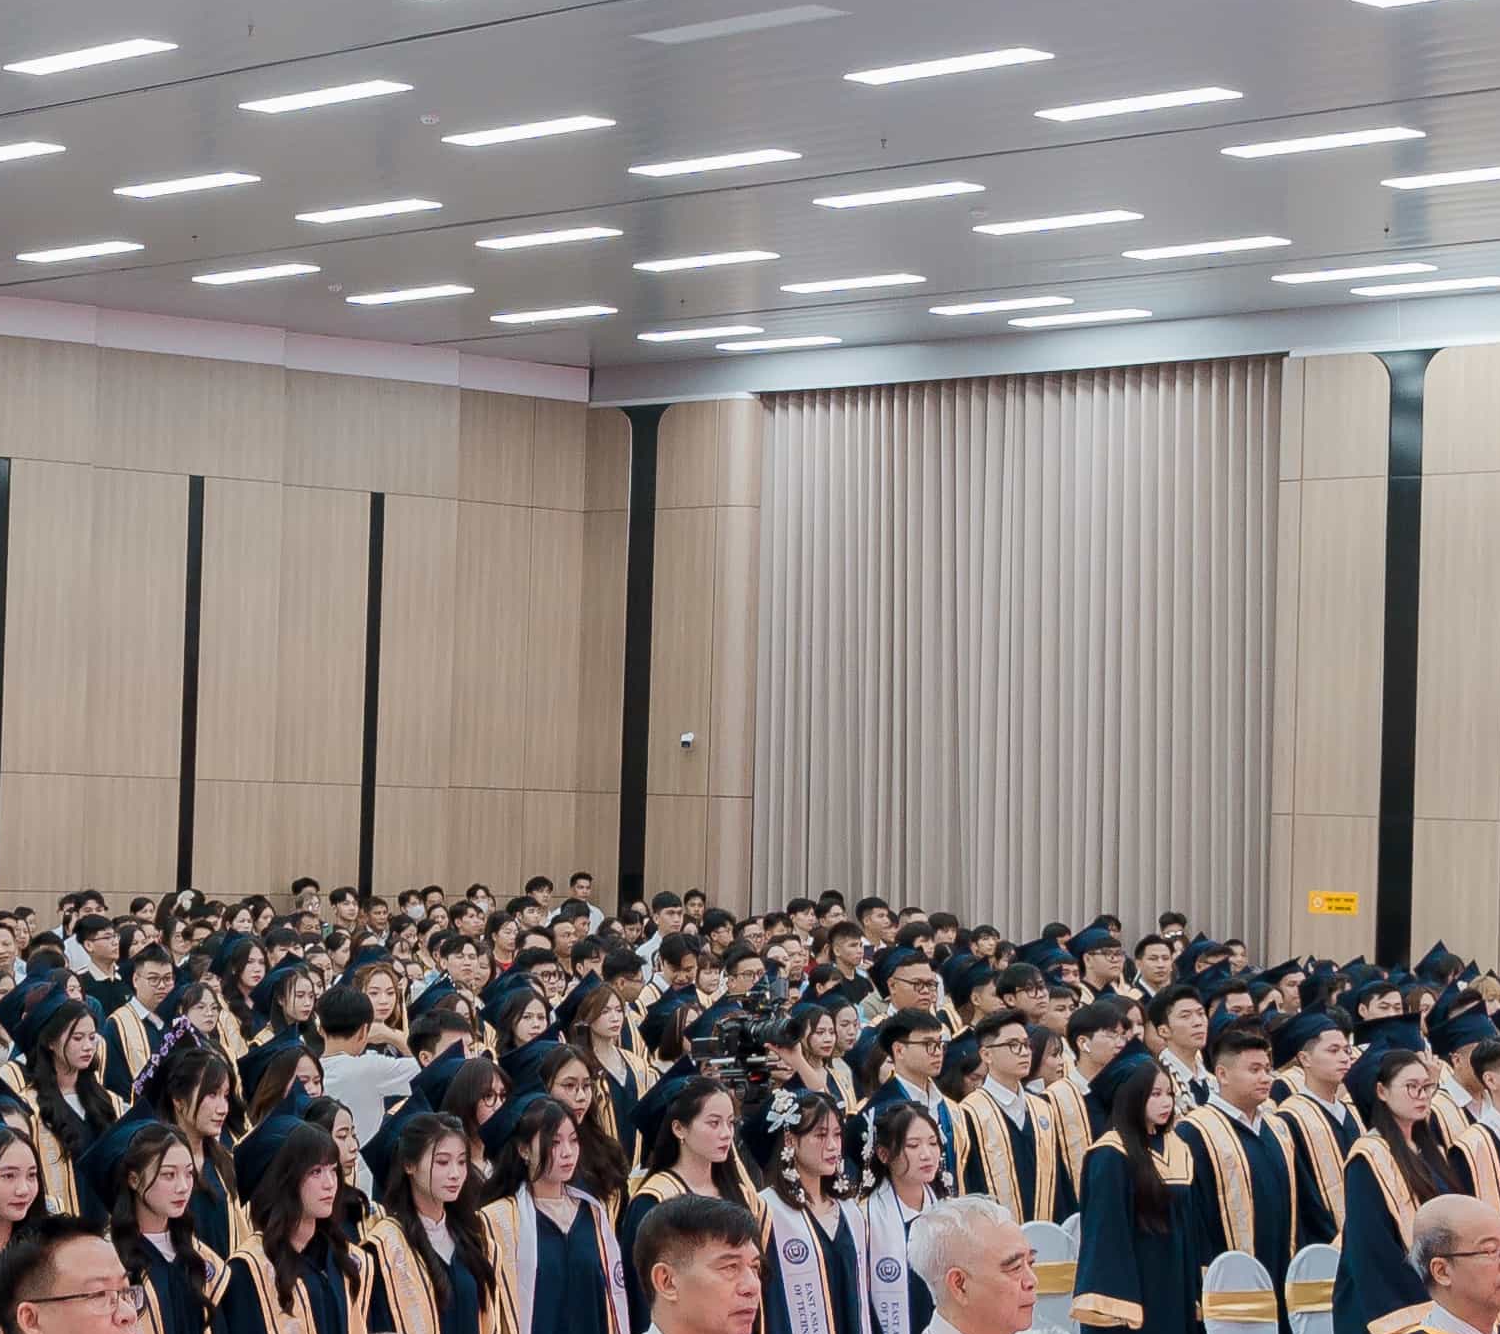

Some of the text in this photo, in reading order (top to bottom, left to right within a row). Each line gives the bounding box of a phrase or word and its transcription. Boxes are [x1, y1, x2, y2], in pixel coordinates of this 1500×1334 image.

[793, 1284, 801, 1296] OF
[804, 1282, 817, 1308] EAST
[808, 1310, 821, 1334] ASIA
[891, 1302, 900, 1327] EAST
